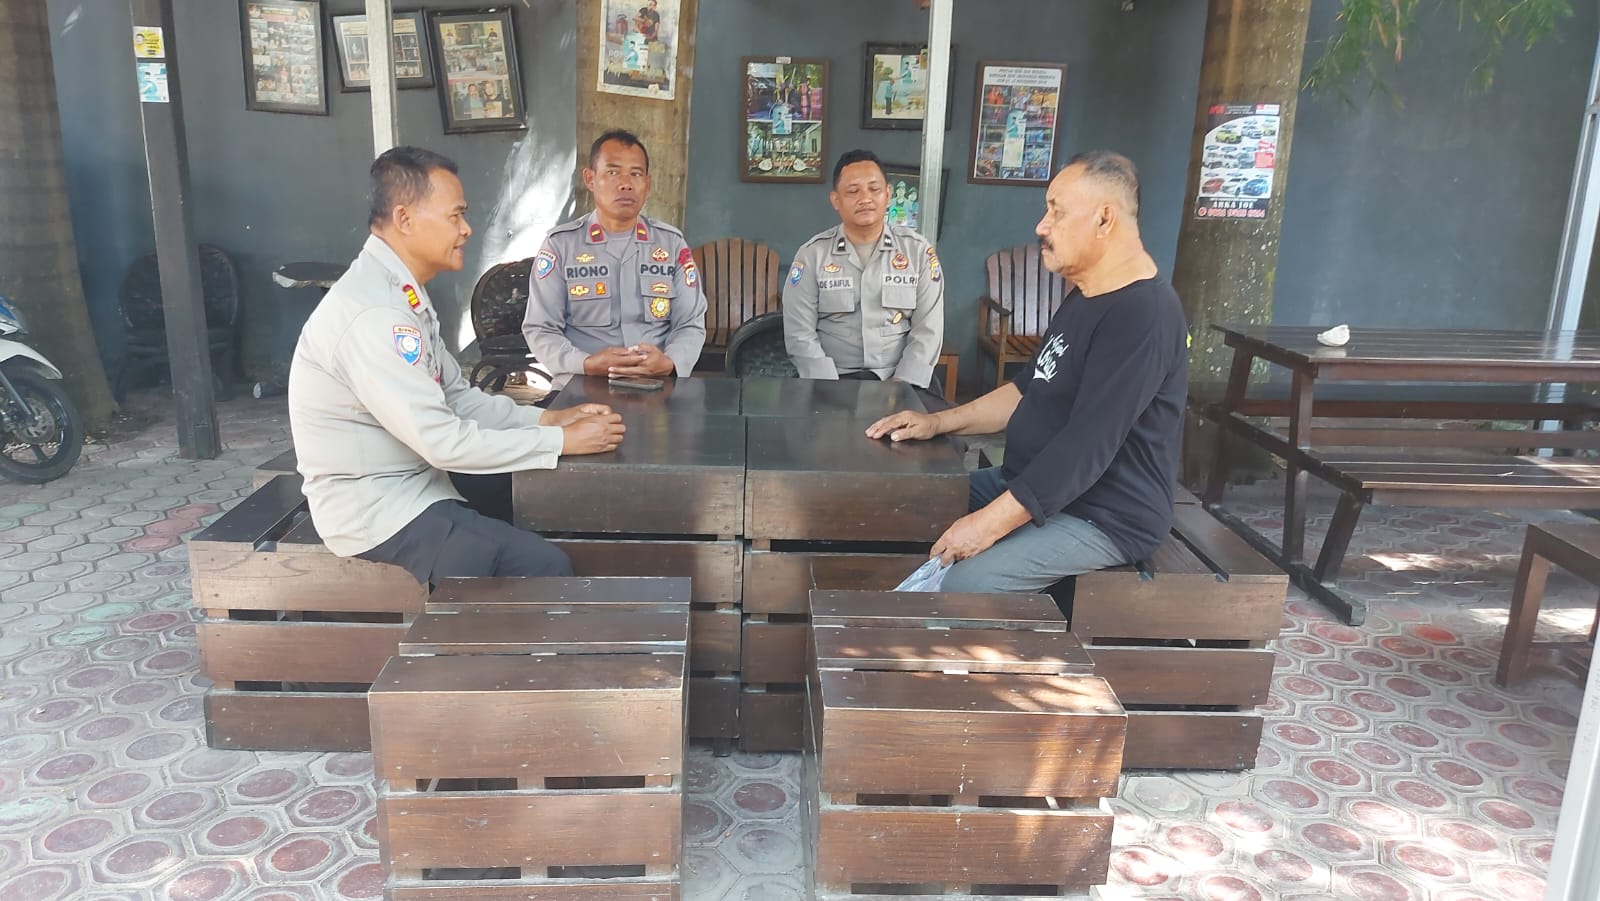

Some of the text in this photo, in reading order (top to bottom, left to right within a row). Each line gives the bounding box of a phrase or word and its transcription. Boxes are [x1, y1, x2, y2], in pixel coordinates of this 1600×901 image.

[566, 265, 609, 278] RIONO
[640, 264, 676, 276] POLR
[829, 279, 851, 288] SAIFUL
